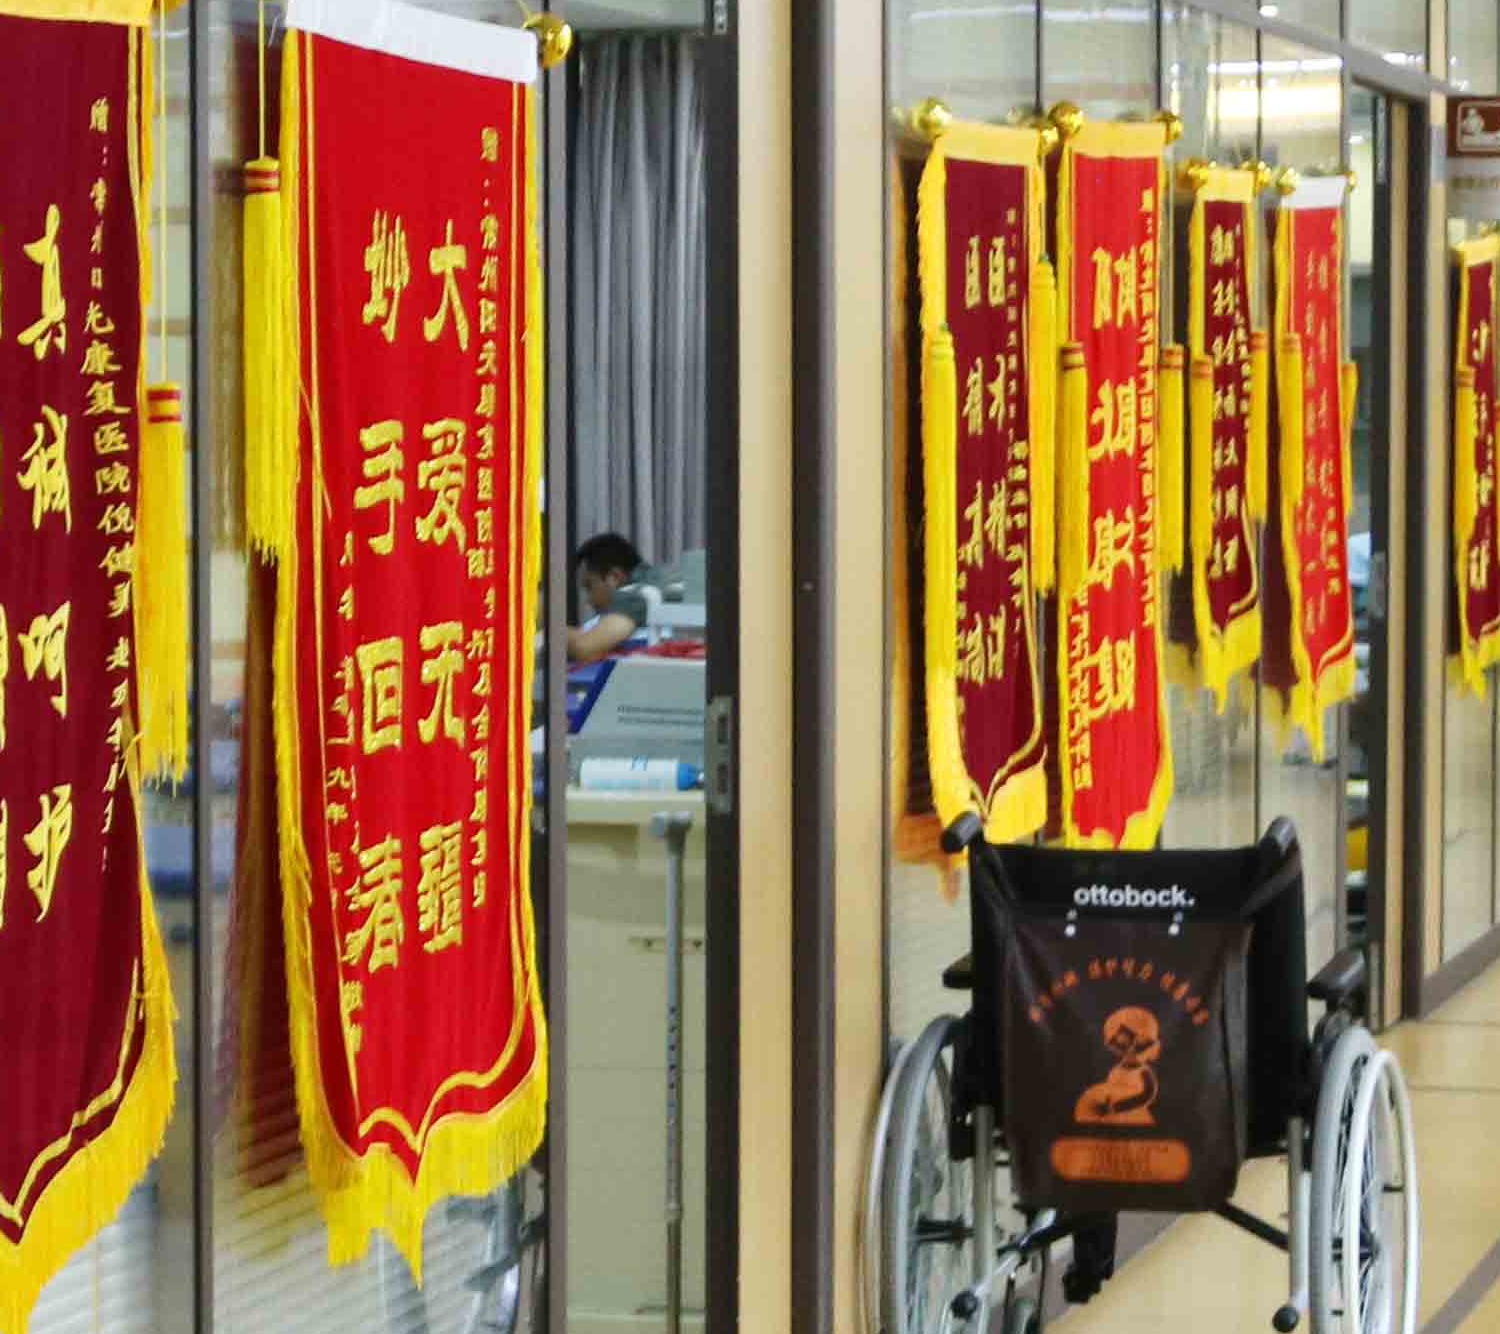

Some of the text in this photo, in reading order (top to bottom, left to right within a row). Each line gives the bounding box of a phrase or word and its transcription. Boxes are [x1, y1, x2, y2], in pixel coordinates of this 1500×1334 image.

[17, 204, 72, 922] 真诚呵护
[354, 211, 410, 973] 妙手回春
[415, 219, 469, 953] 大爱无疆
